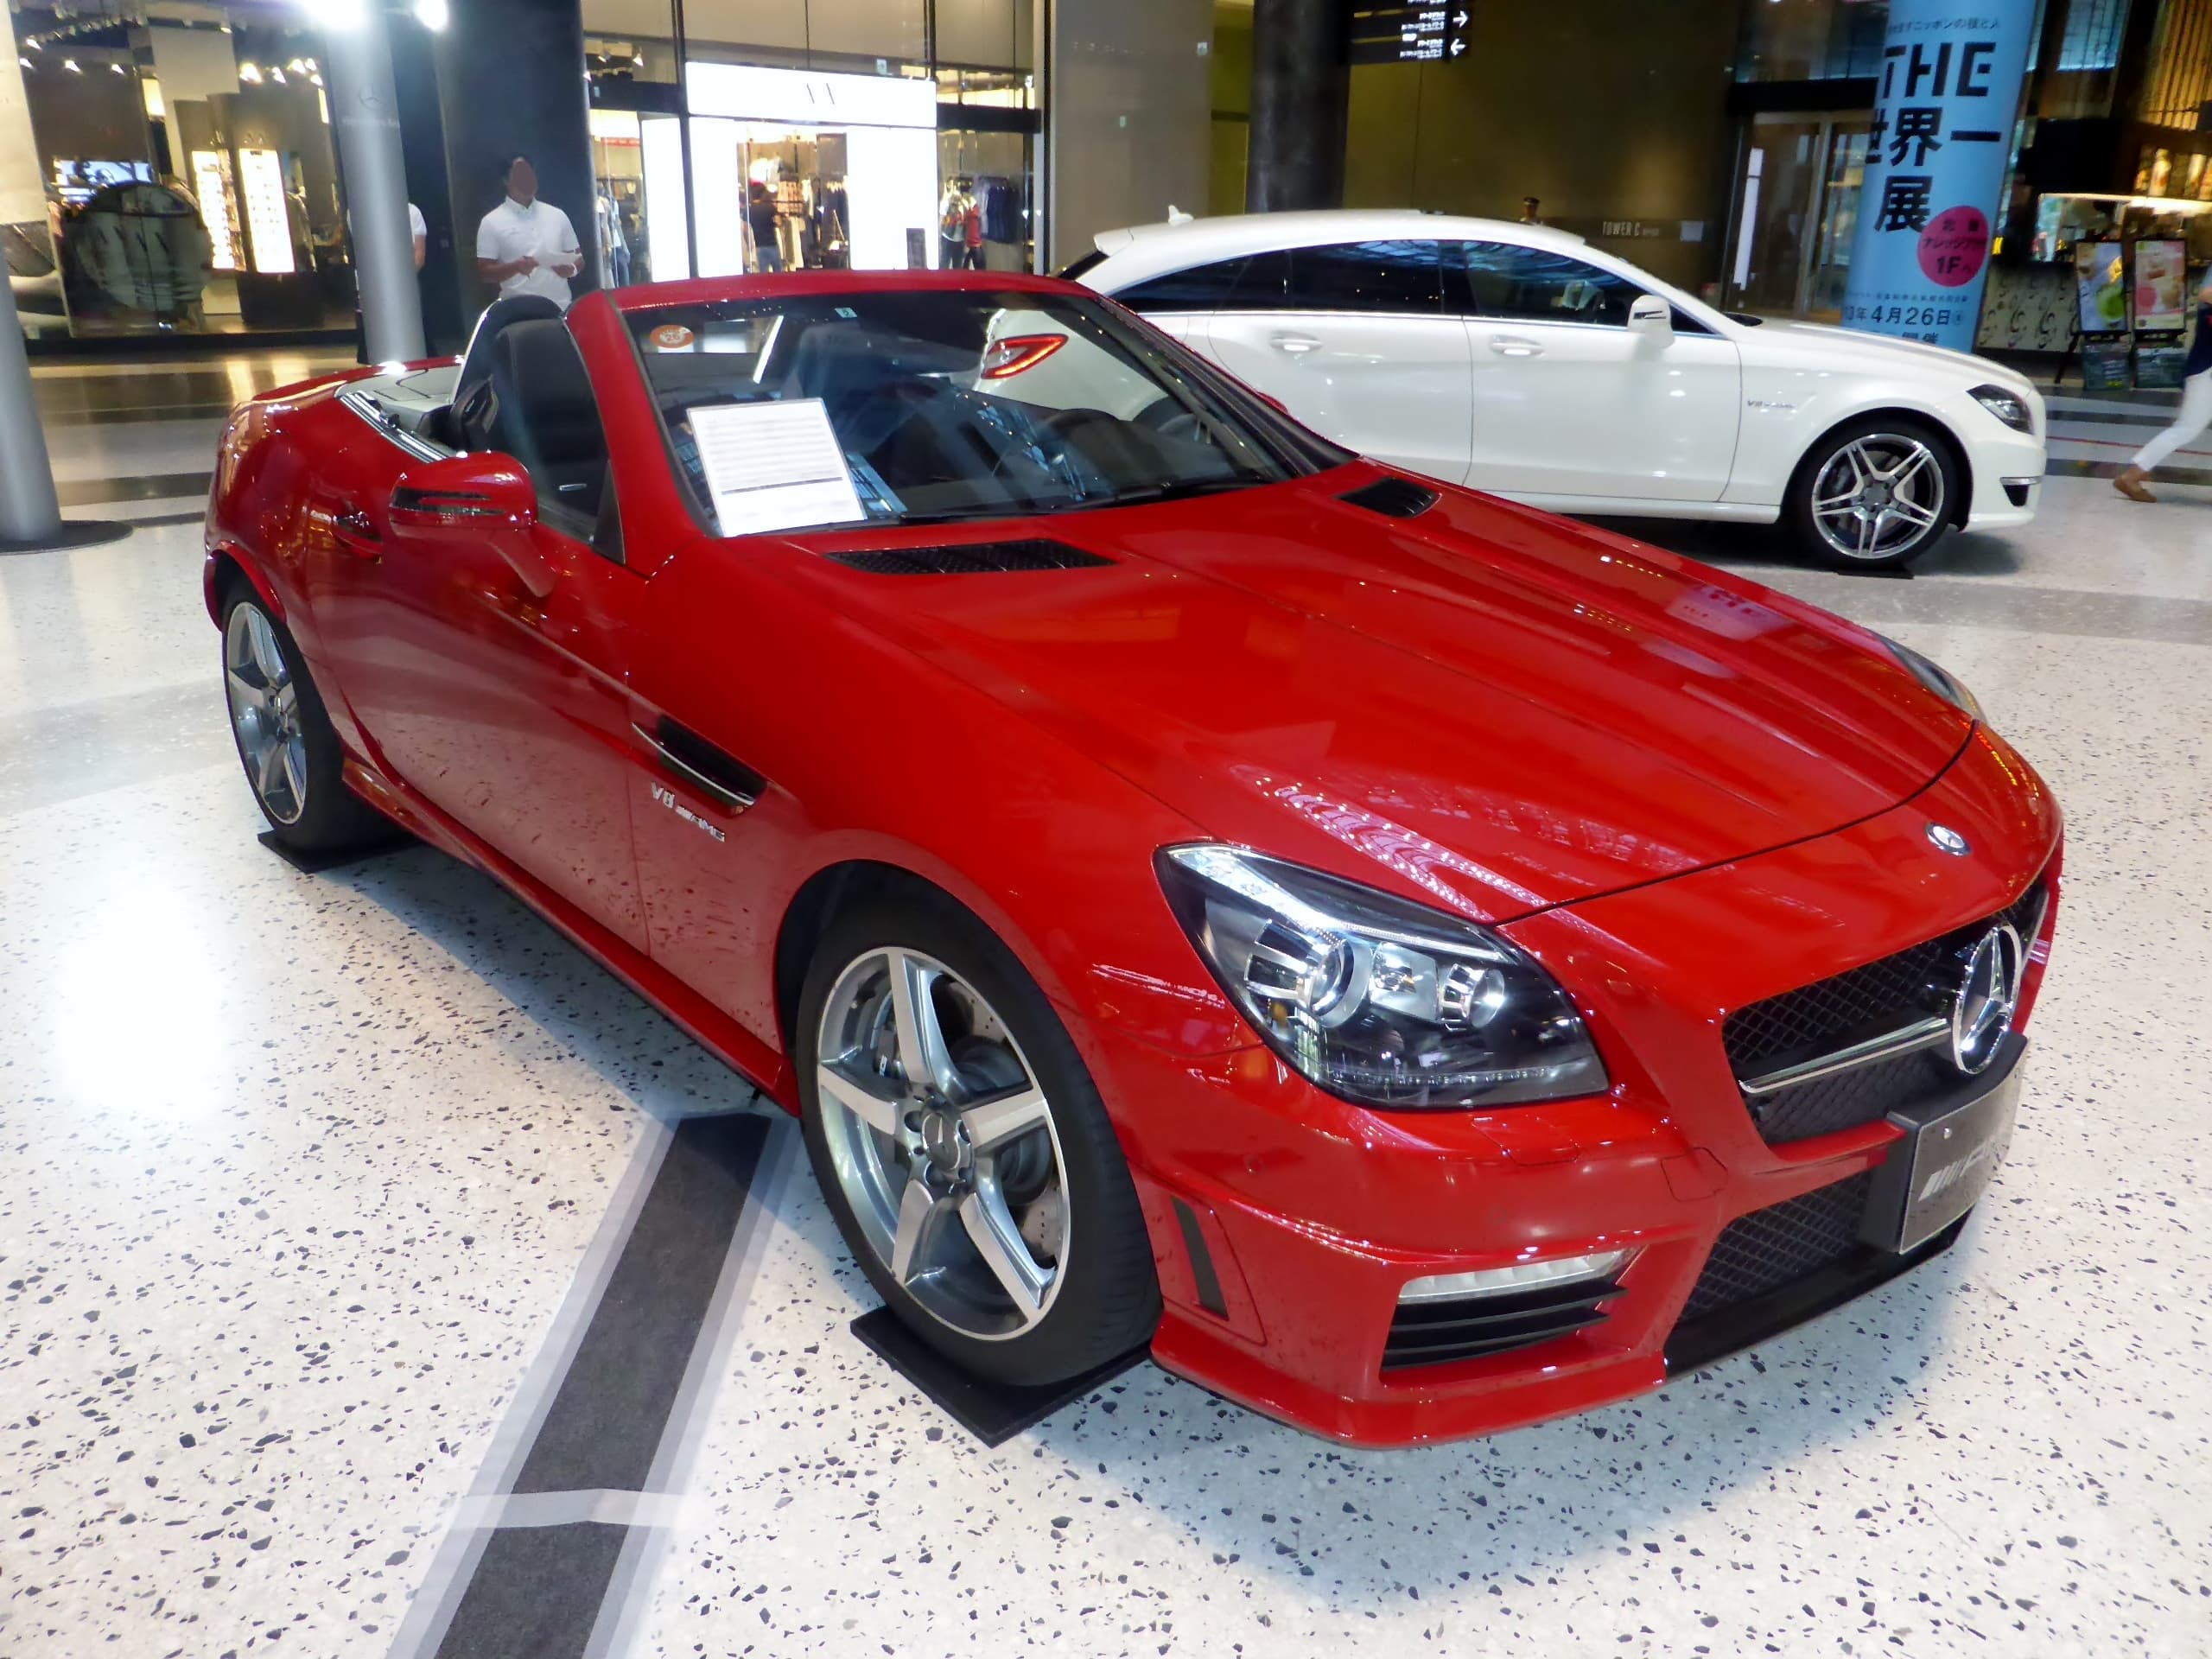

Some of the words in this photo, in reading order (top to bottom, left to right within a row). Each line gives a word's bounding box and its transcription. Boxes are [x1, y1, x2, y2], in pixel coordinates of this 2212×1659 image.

[1883, 42, 1997, 99] THE
[1874, 175, 1934, 232] 展
[651, 781, 676, 809] V8
